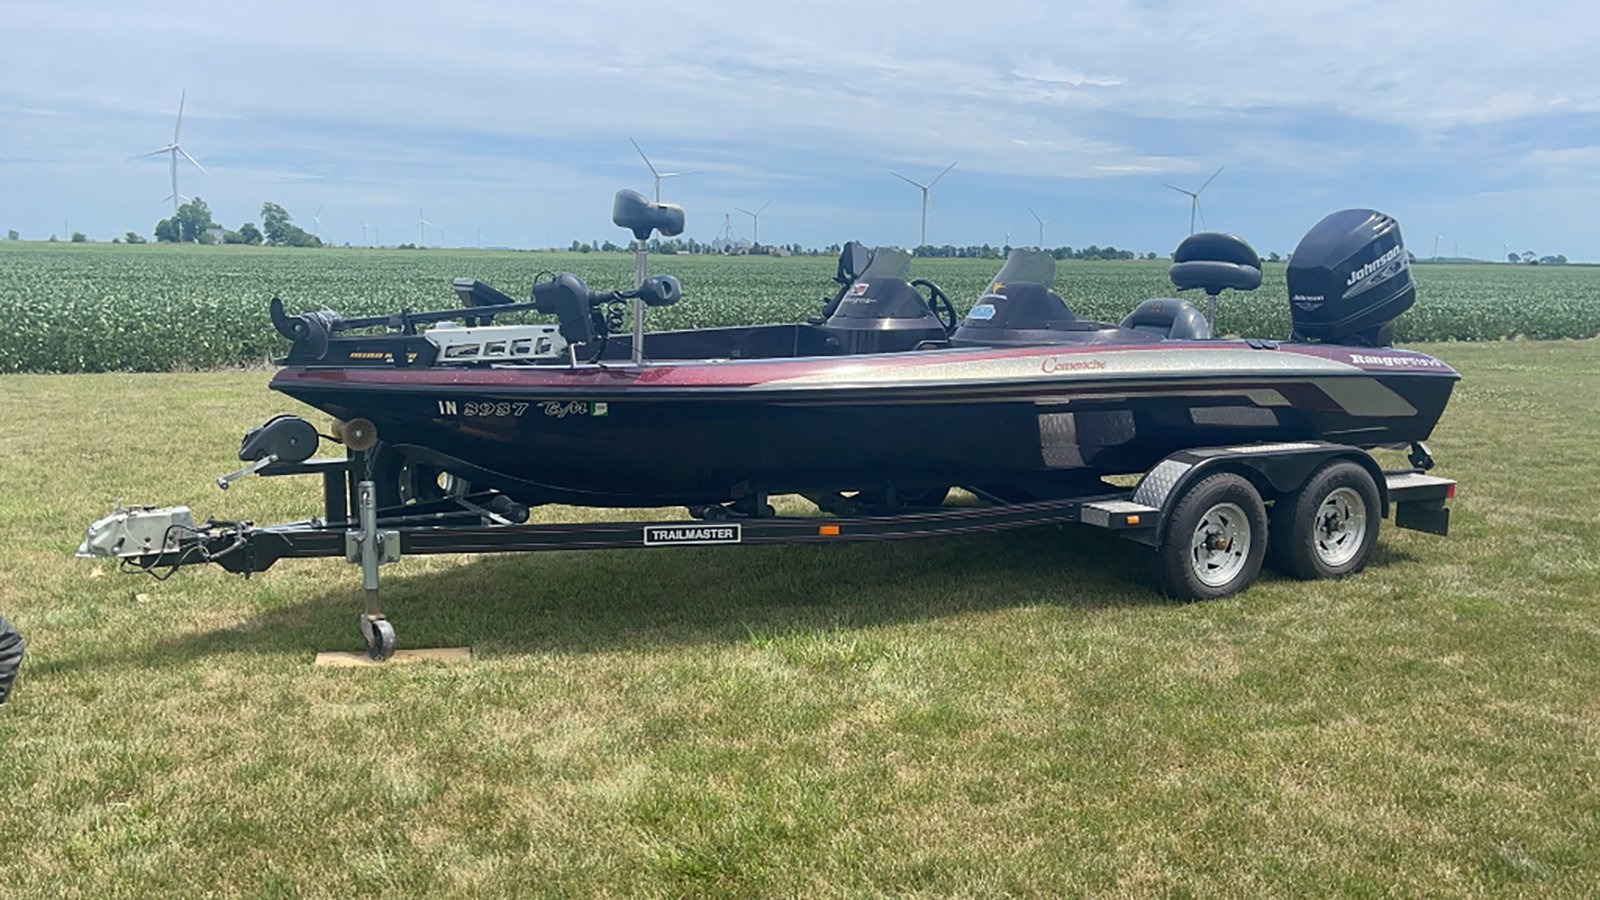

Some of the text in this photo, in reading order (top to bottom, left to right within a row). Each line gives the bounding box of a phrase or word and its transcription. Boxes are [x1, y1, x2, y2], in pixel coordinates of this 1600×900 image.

[1347, 245, 1401, 286] Johnson
[1350, 354, 1412, 367] Ranger
[438, 400, 457, 415] IN
[652, 528, 733, 541] TRAILMASTER
